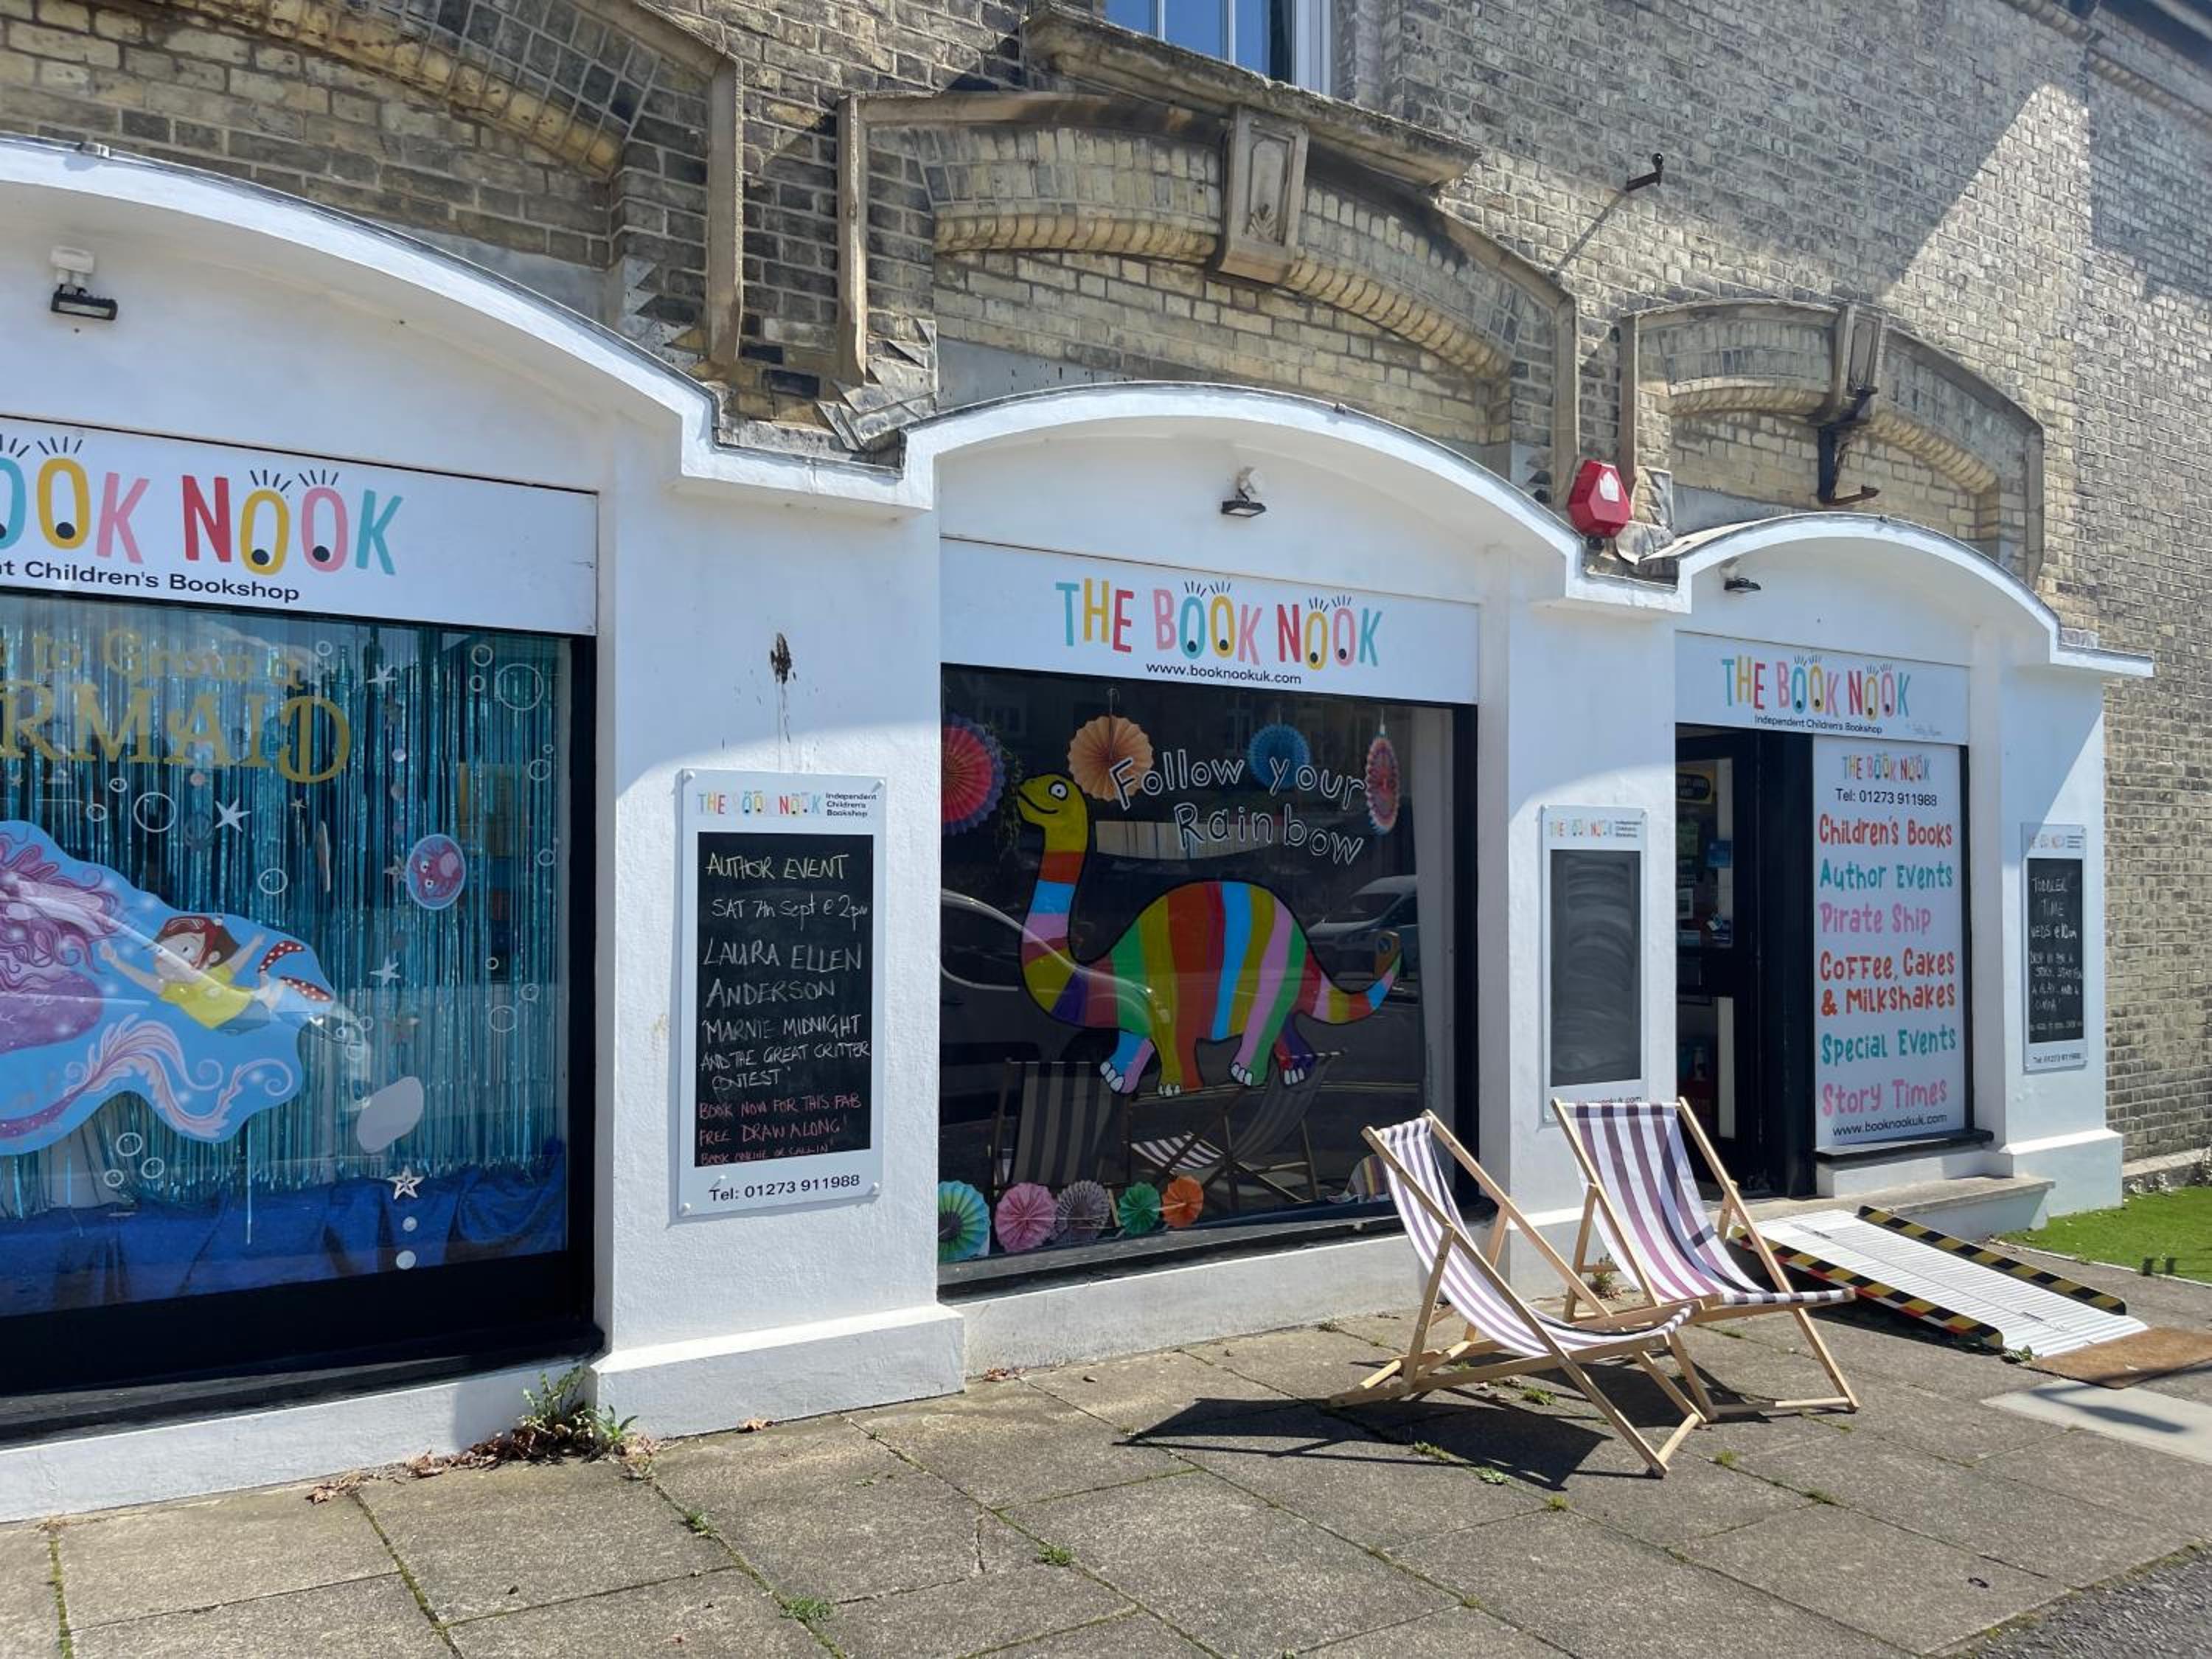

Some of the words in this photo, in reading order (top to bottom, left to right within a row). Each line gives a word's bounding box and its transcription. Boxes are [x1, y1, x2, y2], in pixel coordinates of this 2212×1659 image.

[181, 474, 404, 576] NOOK
[24, 561, 159, 588] Children's
[170, 574, 299, 604] Bookshop
[1055, 578, 1135, 653] THE
[1153, 585, 1262, 667] BOOK
[1277, 603, 1383, 671] NOOK
[1147, 663, 1302, 686] www.booknookuk.com
[1722, 655, 1767, 710] THE
[1776, 661, 1840, 718] BOOK
[1848, 667, 1911, 722] NOOK
[1754, 715, 1805, 728] Independent
[1806, 718, 1843, 731] Children's
[1845, 722, 1882, 734] Bookshop
[1109, 748, 1245, 812] Follow
[1269, 756, 1368, 811] your
[1842, 754, 1863, 780] THE
[1866, 754, 1897, 781] BOOK
[1900, 756, 1931, 782] NOOK
[698, 792, 726, 815] THE
[825, 793, 877, 801] Independent
[826, 800, 866, 809] Children's
[1835, 788, 1856, 802] Tel:
[1859, 790, 1895, 804] 01273
[1897, 793, 1938, 807] 911988
[826, 809, 869, 818] Bookshop
[1172, 803, 1365, 866] Rainbow
[1819, 813, 1899, 847] Children's
[1907, 818, 1953, 849] Books
[706, 852, 776, 880] AUTHOR
[784, 853, 849, 880] EVENT
[1819, 858, 1887, 891] Author
[1896, 860, 1954, 891] Events
[711, 899, 745, 919] SAT
[1819, 901, 1883, 933] Pirate
[1891, 902, 1932, 935] Ship
[703, 936, 781, 967] LAURA
[790, 943, 863, 973] ELLEN
[1819, 950, 1898, 982] Coffee,
[1902, 947, 1955, 978] Cakes
[705, 978, 835, 1009] ANDERSON
[1820, 988, 1838, 1017] &
[1846, 983, 1956, 1015] Milkshakes
[782, 1014, 862, 1039] MIDNIGHT
[700, 1051, 731, 1071] AND
[730, 1048, 757, 1067] THE
[763, 1043, 809, 1065] GREAT
[813, 1040, 871, 1060] CRITTER
[1821, 1032, 1888, 1067] Special
[1898, 1023, 1956, 1057] Events
[700, 1101, 734, 1121] BOOK
[740, 1101, 768, 1118] NOW
[773, 1098, 801, 1114] FOR
[801, 1094, 831, 1110] THIS
[1822, 1082, 1882, 1117] Story
[1892, 1078, 1947, 1110] Times
[699, 1130, 732, 1147] FREE
[742, 1123, 785, 1144] DRAW
[1832, 1113, 1947, 1136] www.booknookuk.com
[709, 1188, 740, 1202] Tel:
[744, 1180, 796, 1198] 01273
[801, 1174, 860, 1191] 911988
